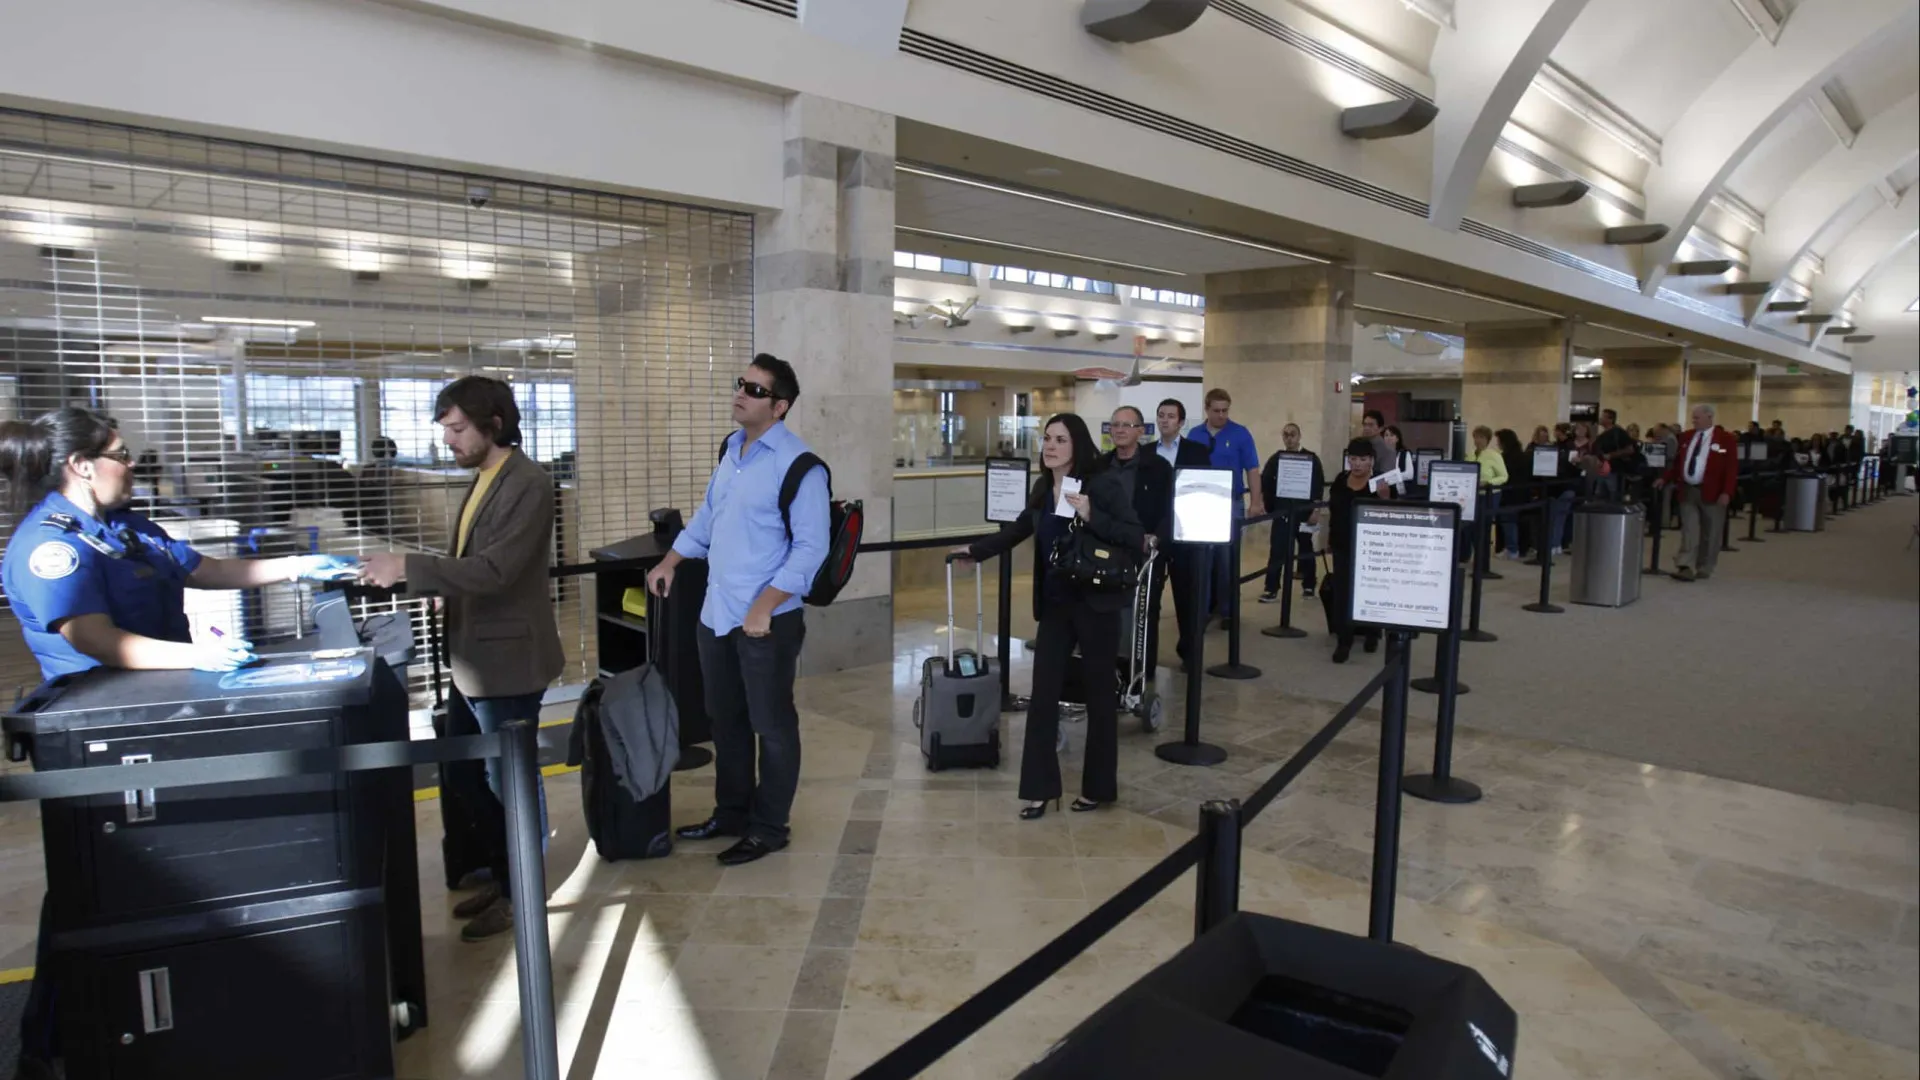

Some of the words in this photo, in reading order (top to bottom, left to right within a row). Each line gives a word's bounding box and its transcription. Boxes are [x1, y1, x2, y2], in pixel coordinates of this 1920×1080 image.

[1413, 514, 1439, 522] Security
[1378, 600, 1397, 608] safety
[1415, 603, 1439, 612] priority
